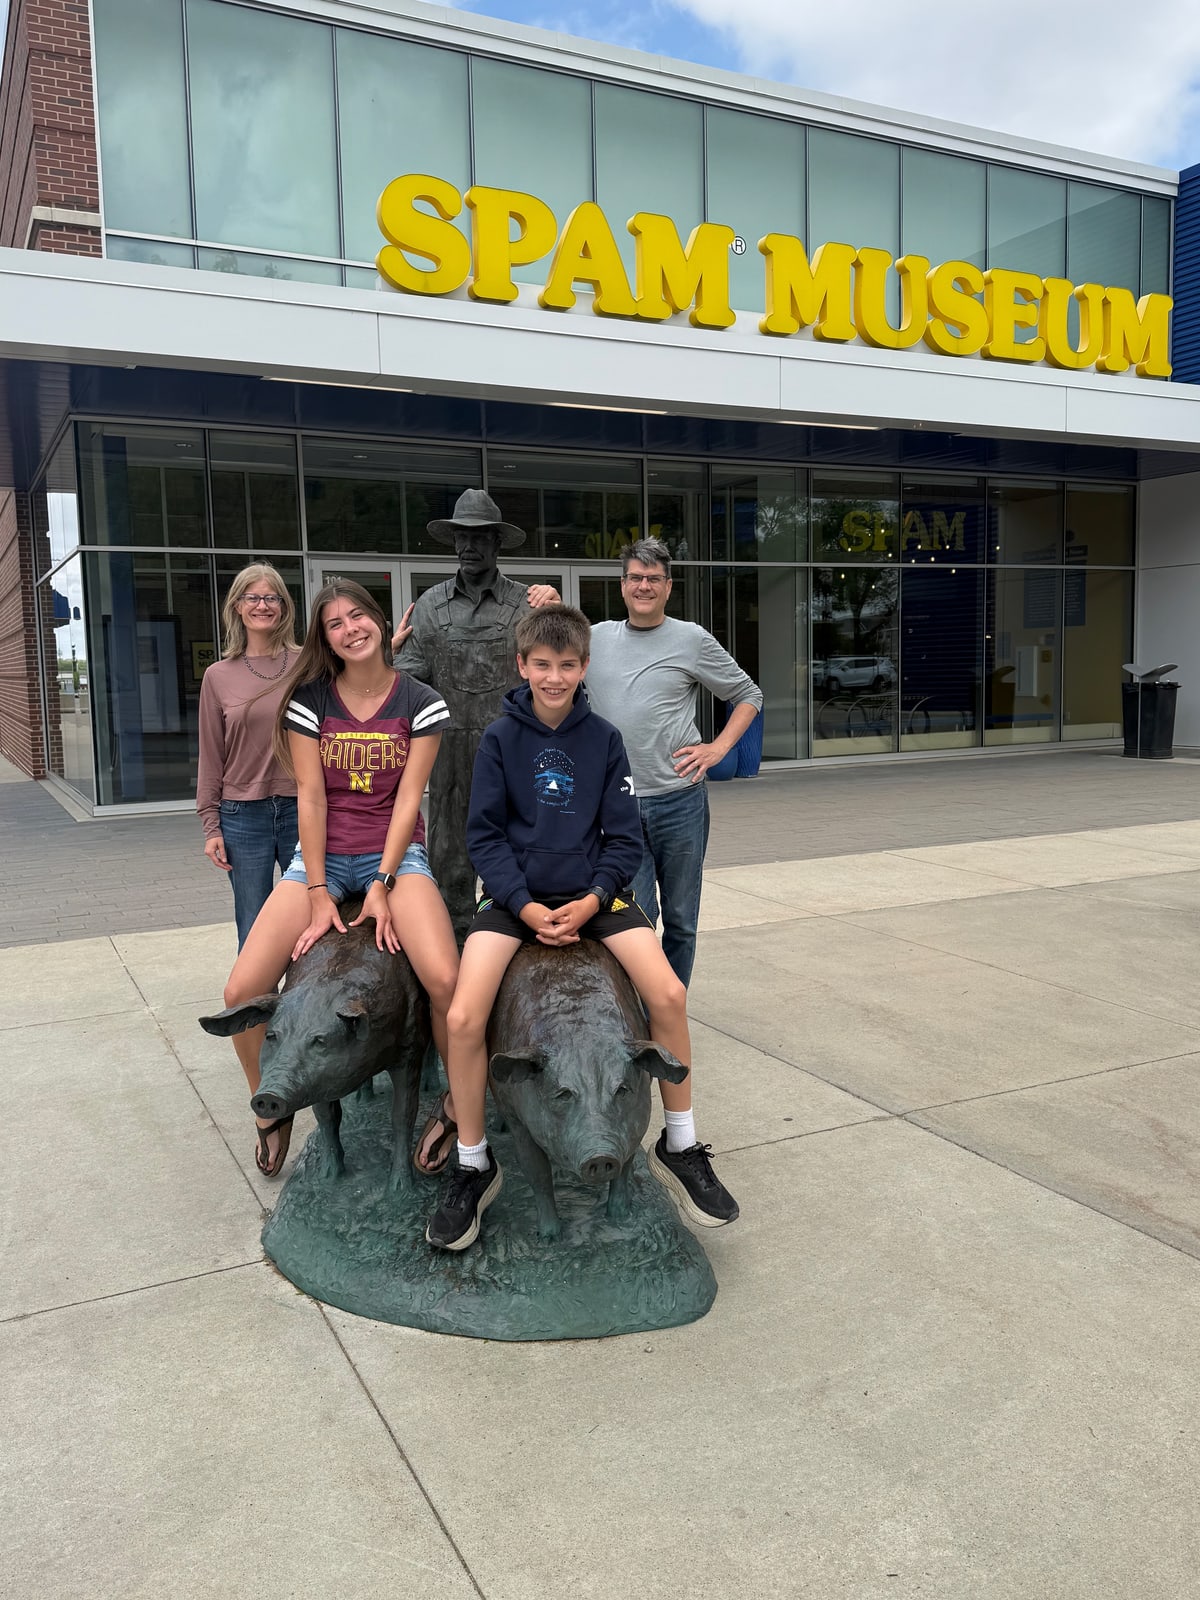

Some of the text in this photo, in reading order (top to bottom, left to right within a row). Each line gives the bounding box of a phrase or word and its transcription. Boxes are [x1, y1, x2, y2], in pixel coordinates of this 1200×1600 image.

[758, 232, 1174, 378] MUSEUM
[320, 737, 407, 770] RAIDERS
[348, 771, 374, 794] N
